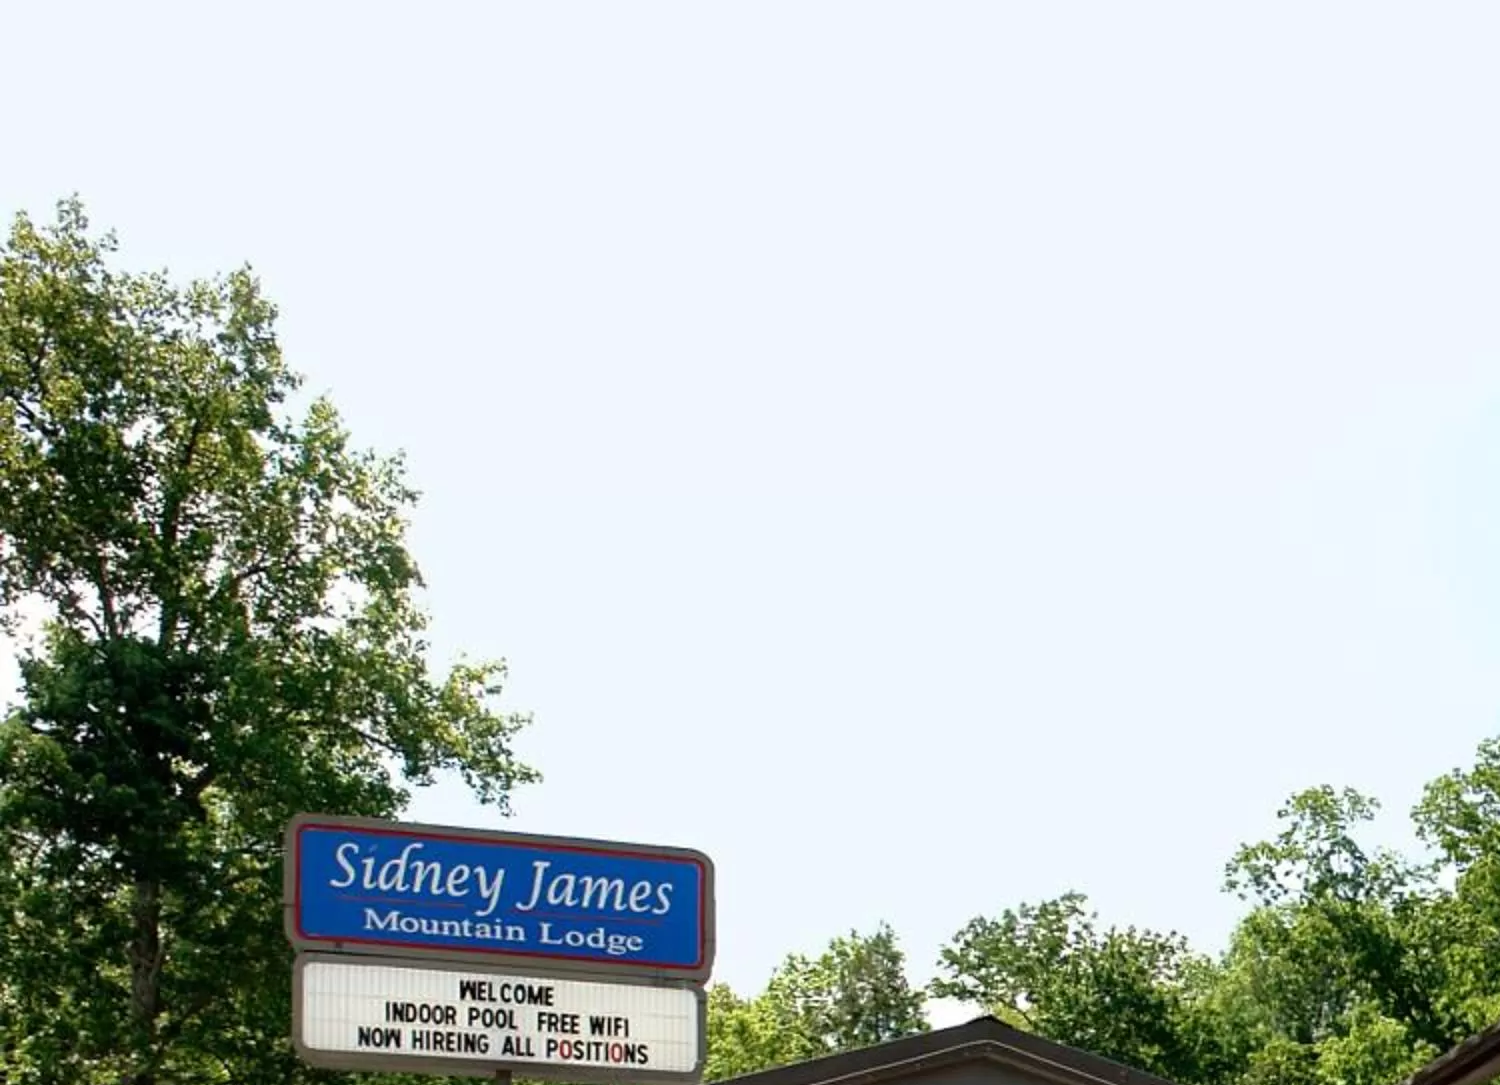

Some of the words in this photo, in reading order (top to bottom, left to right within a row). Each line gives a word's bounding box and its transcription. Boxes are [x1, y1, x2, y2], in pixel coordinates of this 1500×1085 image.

[329, 842, 505, 916] Sidney
[516, 861, 674, 916] James
[363, 907, 526, 942] Mountain
[539, 922, 645, 956] Lodge
[459, 980, 555, 1007] WELCOME
[385, 1001, 457, 1026] INDOOR
[467, 1007, 518, 1030] POOL
[537, 1012, 580, 1035] FREE
[589, 1015, 630, 1038] WIFI
[357, 1026, 402, 1049] NOW
[411, 1029, 490, 1054] HIREING
[501, 1035, 536, 1057] ALL
[546, 1038, 649, 1065] POSITIONS
